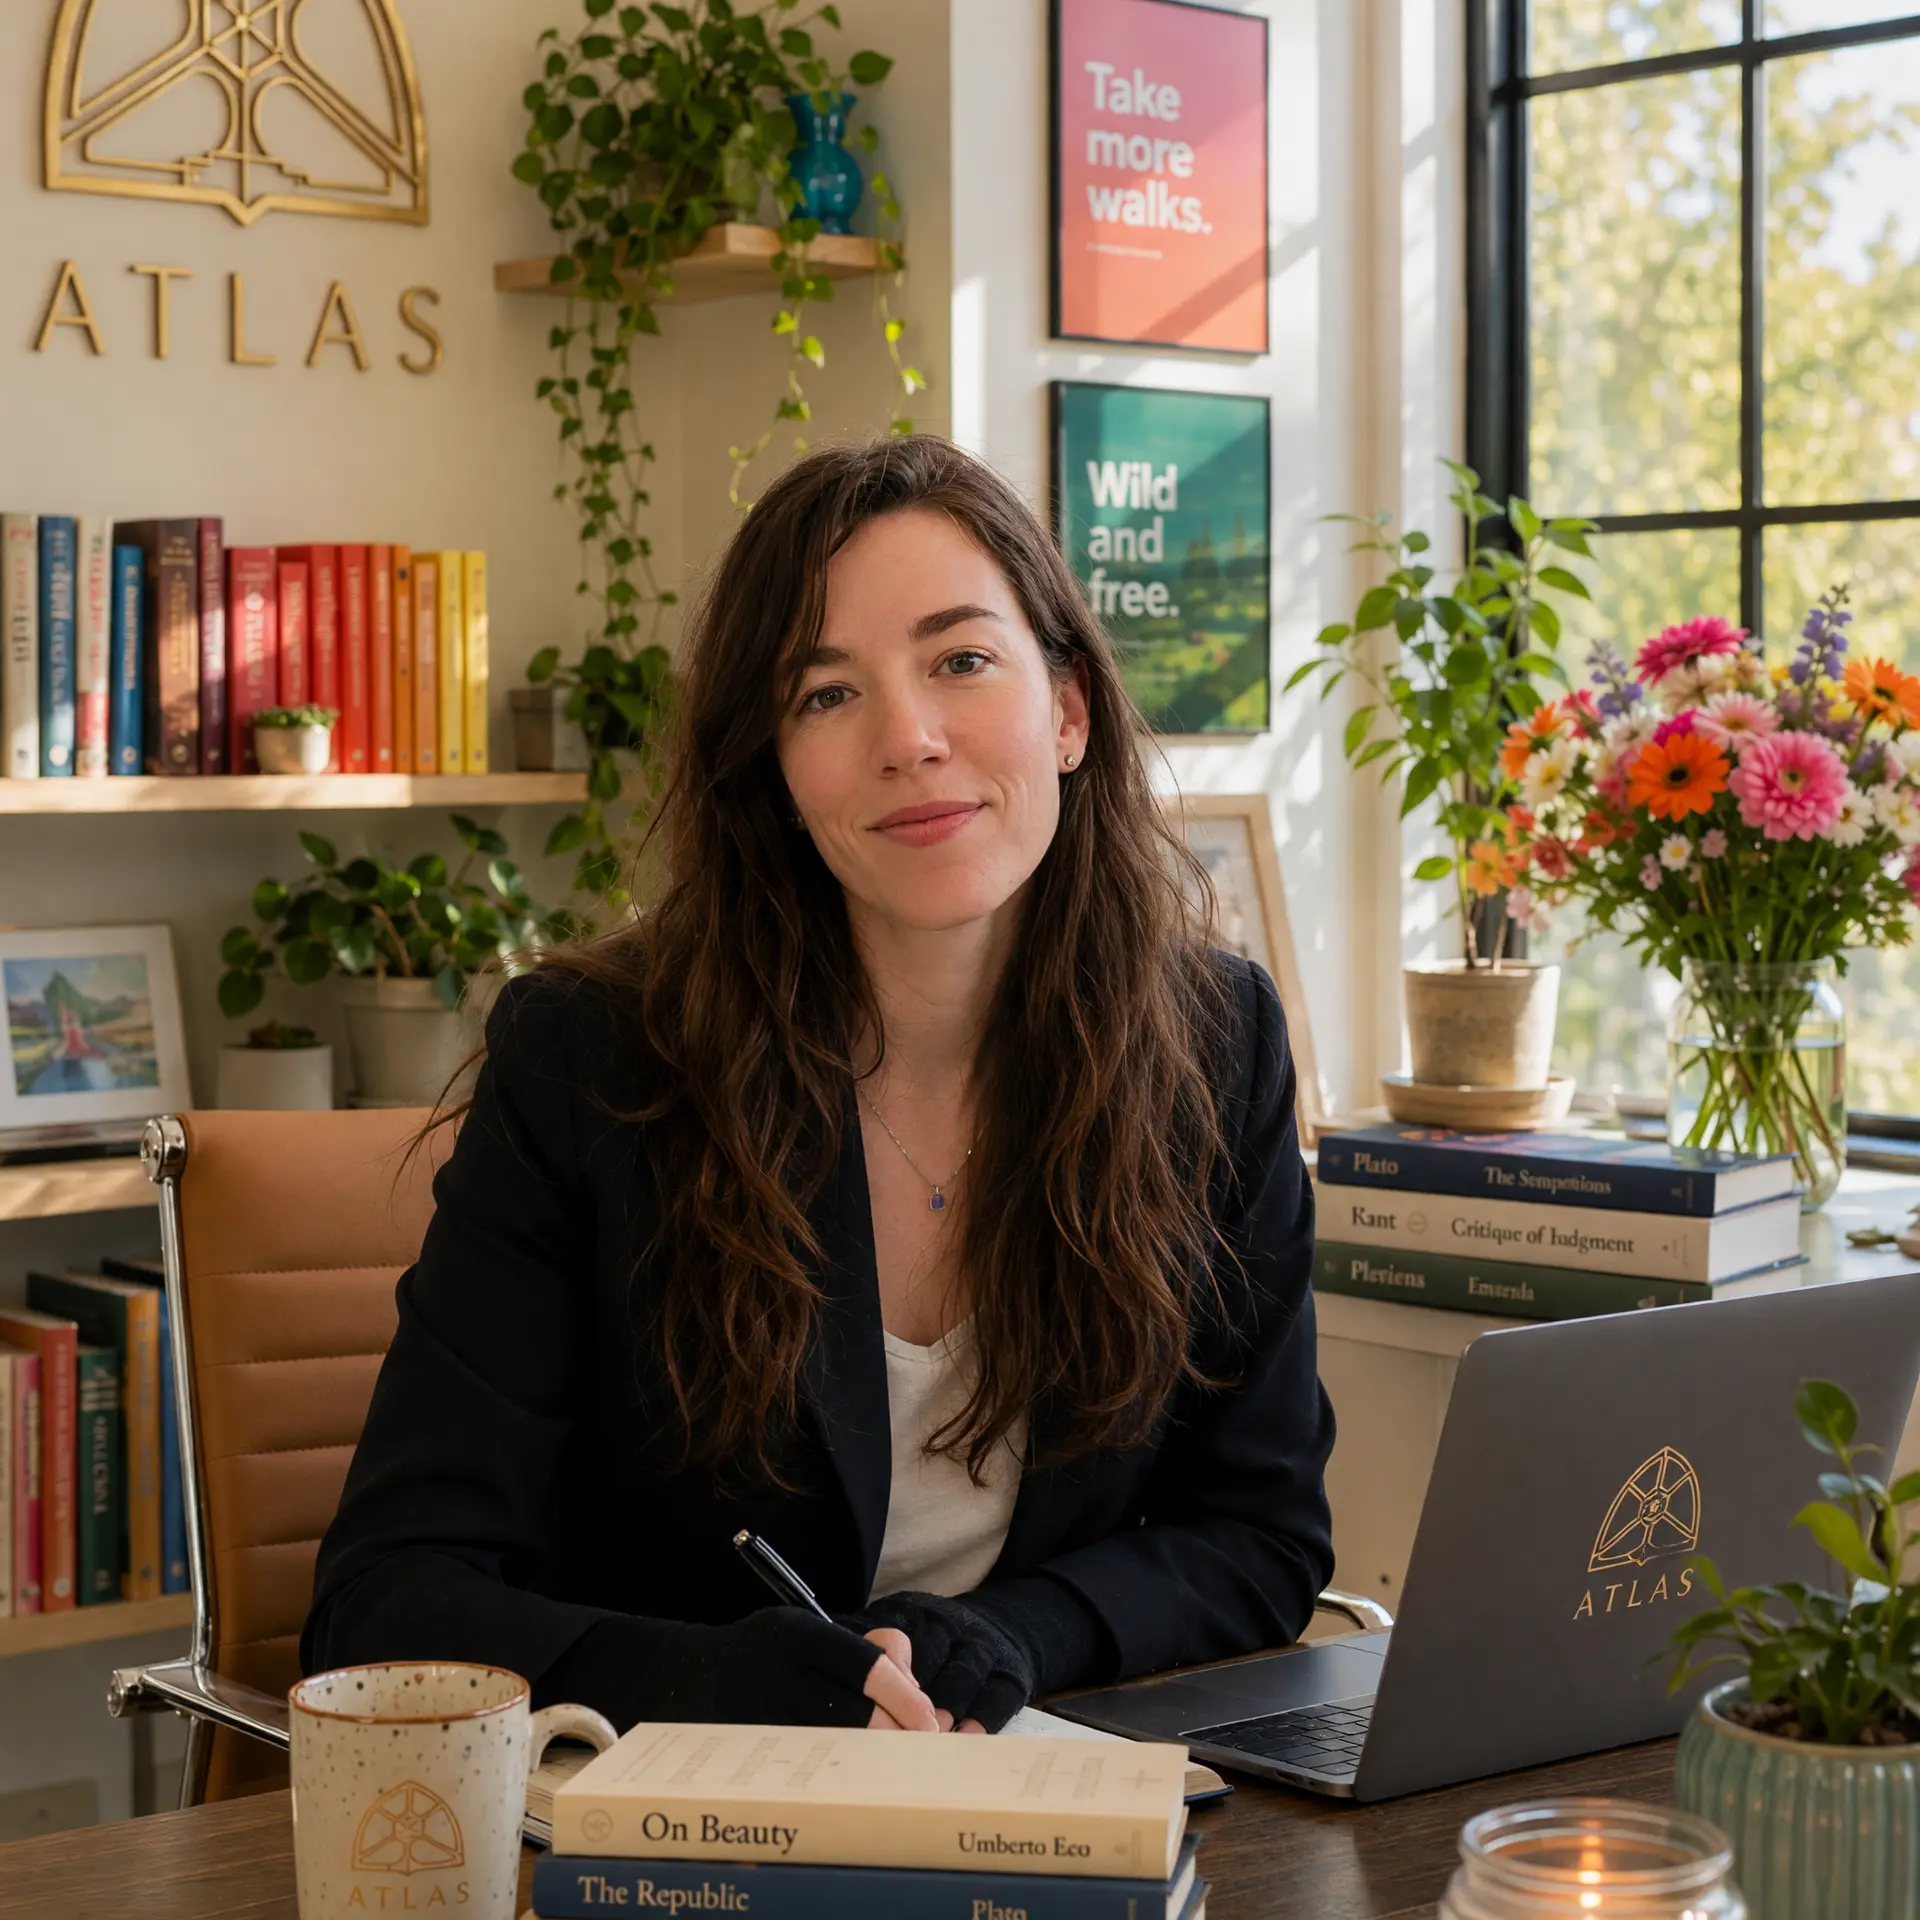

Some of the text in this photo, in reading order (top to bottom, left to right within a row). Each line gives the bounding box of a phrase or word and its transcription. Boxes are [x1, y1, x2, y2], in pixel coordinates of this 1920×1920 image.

[1084, 60, 1182, 122] Take
[1086, 129, 1195, 178] more
[1086, 179, 1213, 235] walks.
[32, 259, 444, 375] ATLAS
[1086, 460, 1179, 512] Wild
[1087, 515, 1164, 563] and
[1087, 567, 1180, 618] free.
[1353, 1152, 1399, 1175] Plato
[1484, 1166, 1515, 1186] The
[1351, 1205, 1397, 1230] Kant
[1451, 1217, 1523, 1246] Critique
[1525, 1225, 1547, 1245] of
[1572, 1567, 1694, 1620] ATLAS
[641, 1812, 799, 1855] On Beauty
[957, 1832, 1091, 1858] Umberto Eco
[348, 1881, 470, 1911] ATLAS
[577, 1875, 750, 1916] The Republic
